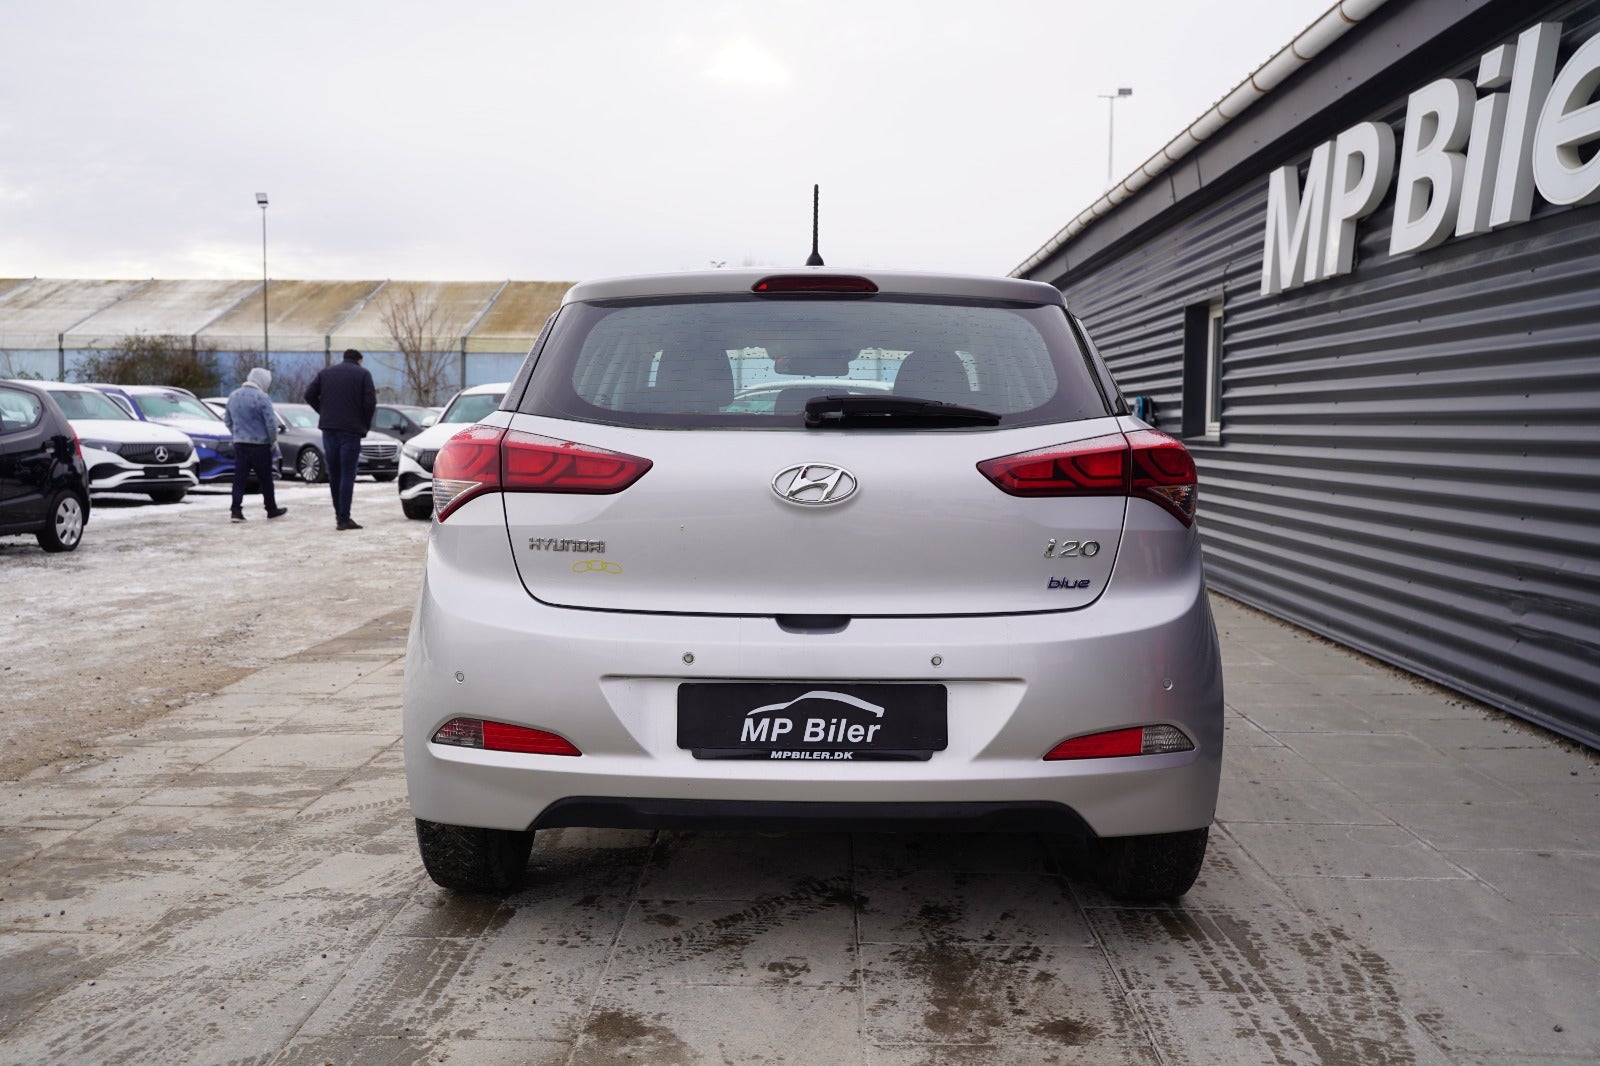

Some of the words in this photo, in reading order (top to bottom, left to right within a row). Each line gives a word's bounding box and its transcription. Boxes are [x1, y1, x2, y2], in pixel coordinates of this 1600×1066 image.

[1260, 121, 1396, 296] MP
[528, 537, 606, 553] HYUNDAI
[1047, 576, 1091, 589] blue
[741, 718, 793, 742] MP
[804, 718, 881, 743] Biler
[770, 750, 853, 760] MPBILER.DK
